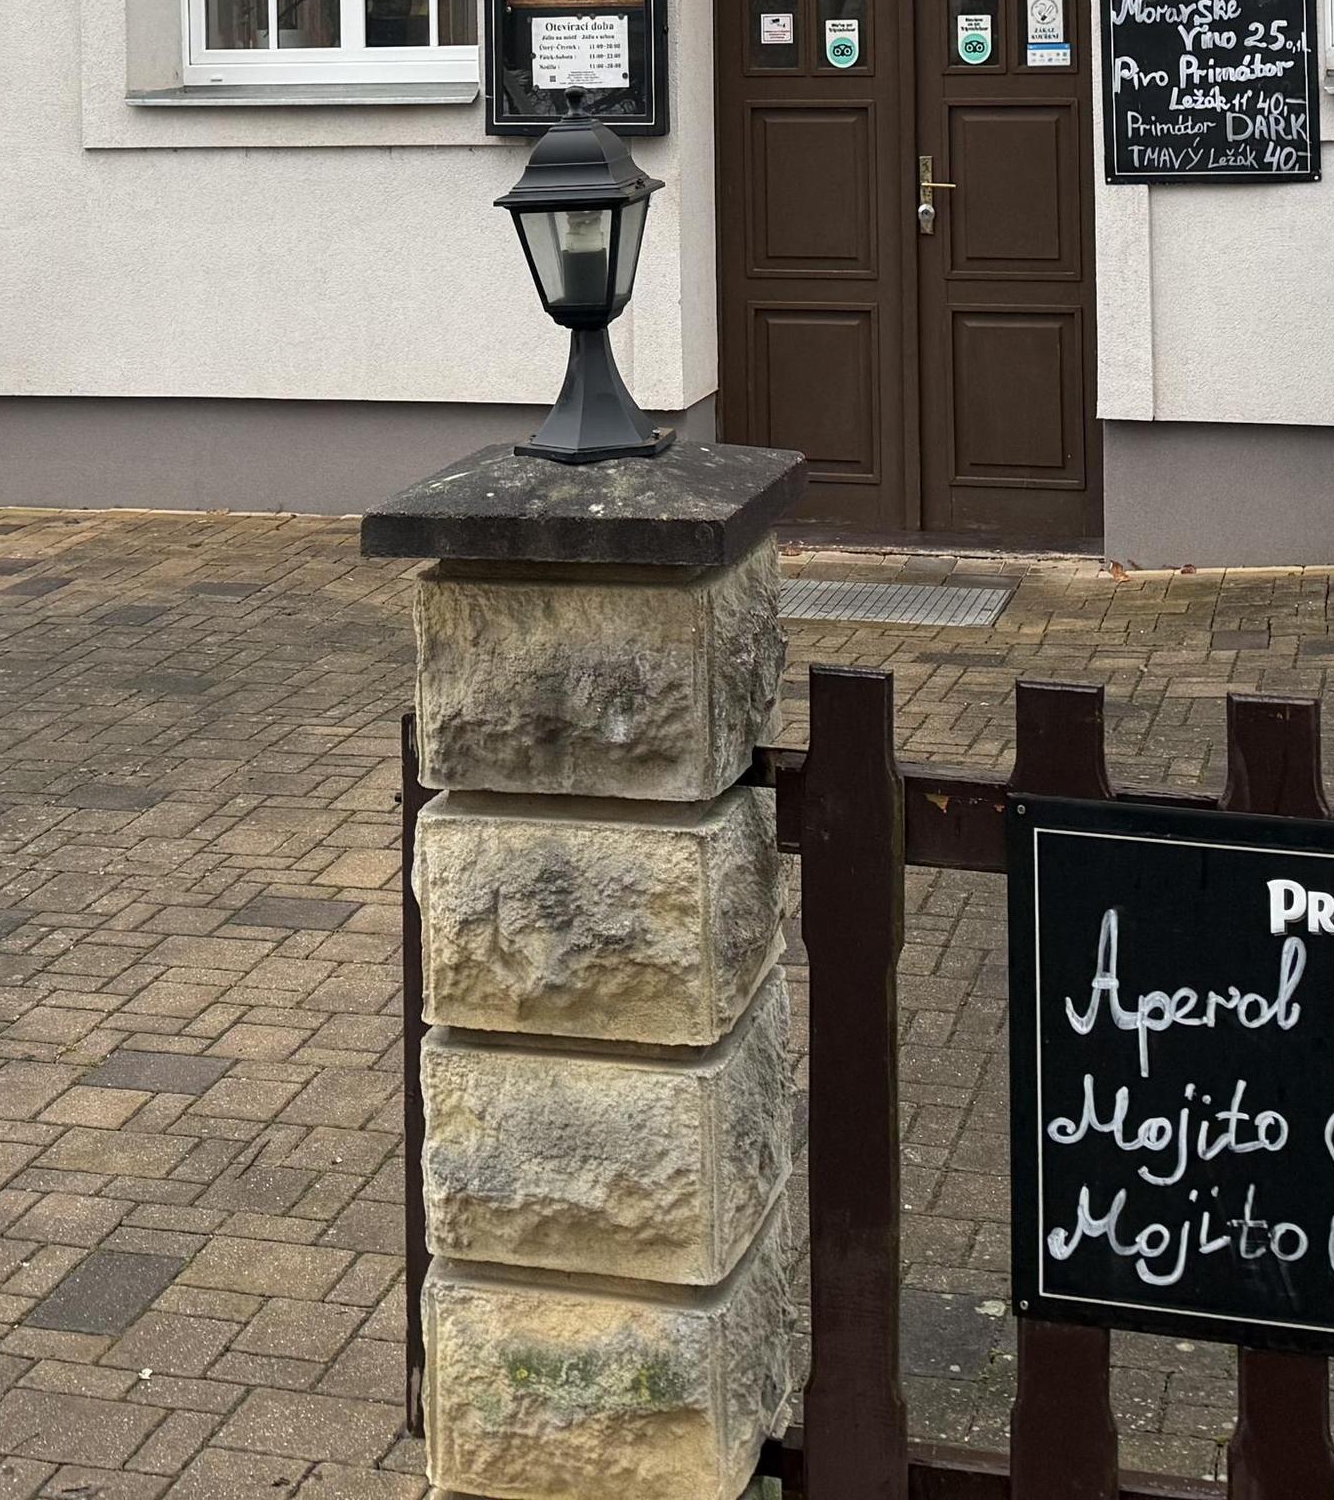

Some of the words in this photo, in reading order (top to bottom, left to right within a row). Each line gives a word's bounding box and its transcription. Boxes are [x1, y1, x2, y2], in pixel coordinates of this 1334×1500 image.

[591, 22, 614, 31] doba
[1113, 56, 1168, 94] Pivo
[1179, 53, 1294, 88] Primátor
[1169, 85, 1231, 112] Ležák
[1127, 110, 1217, 139] Primátor
[1226, 111, 1308, 142] DARK
[1127, 137, 1204, 170] TMAVÝ
[1208, 143, 1259, 169] Ležák
[1065, 908, 1306, 1078] Aperol
[1048, 1073, 1289, 1185] Mojito
[1048, 1184, 1309, 1286] Mojito
